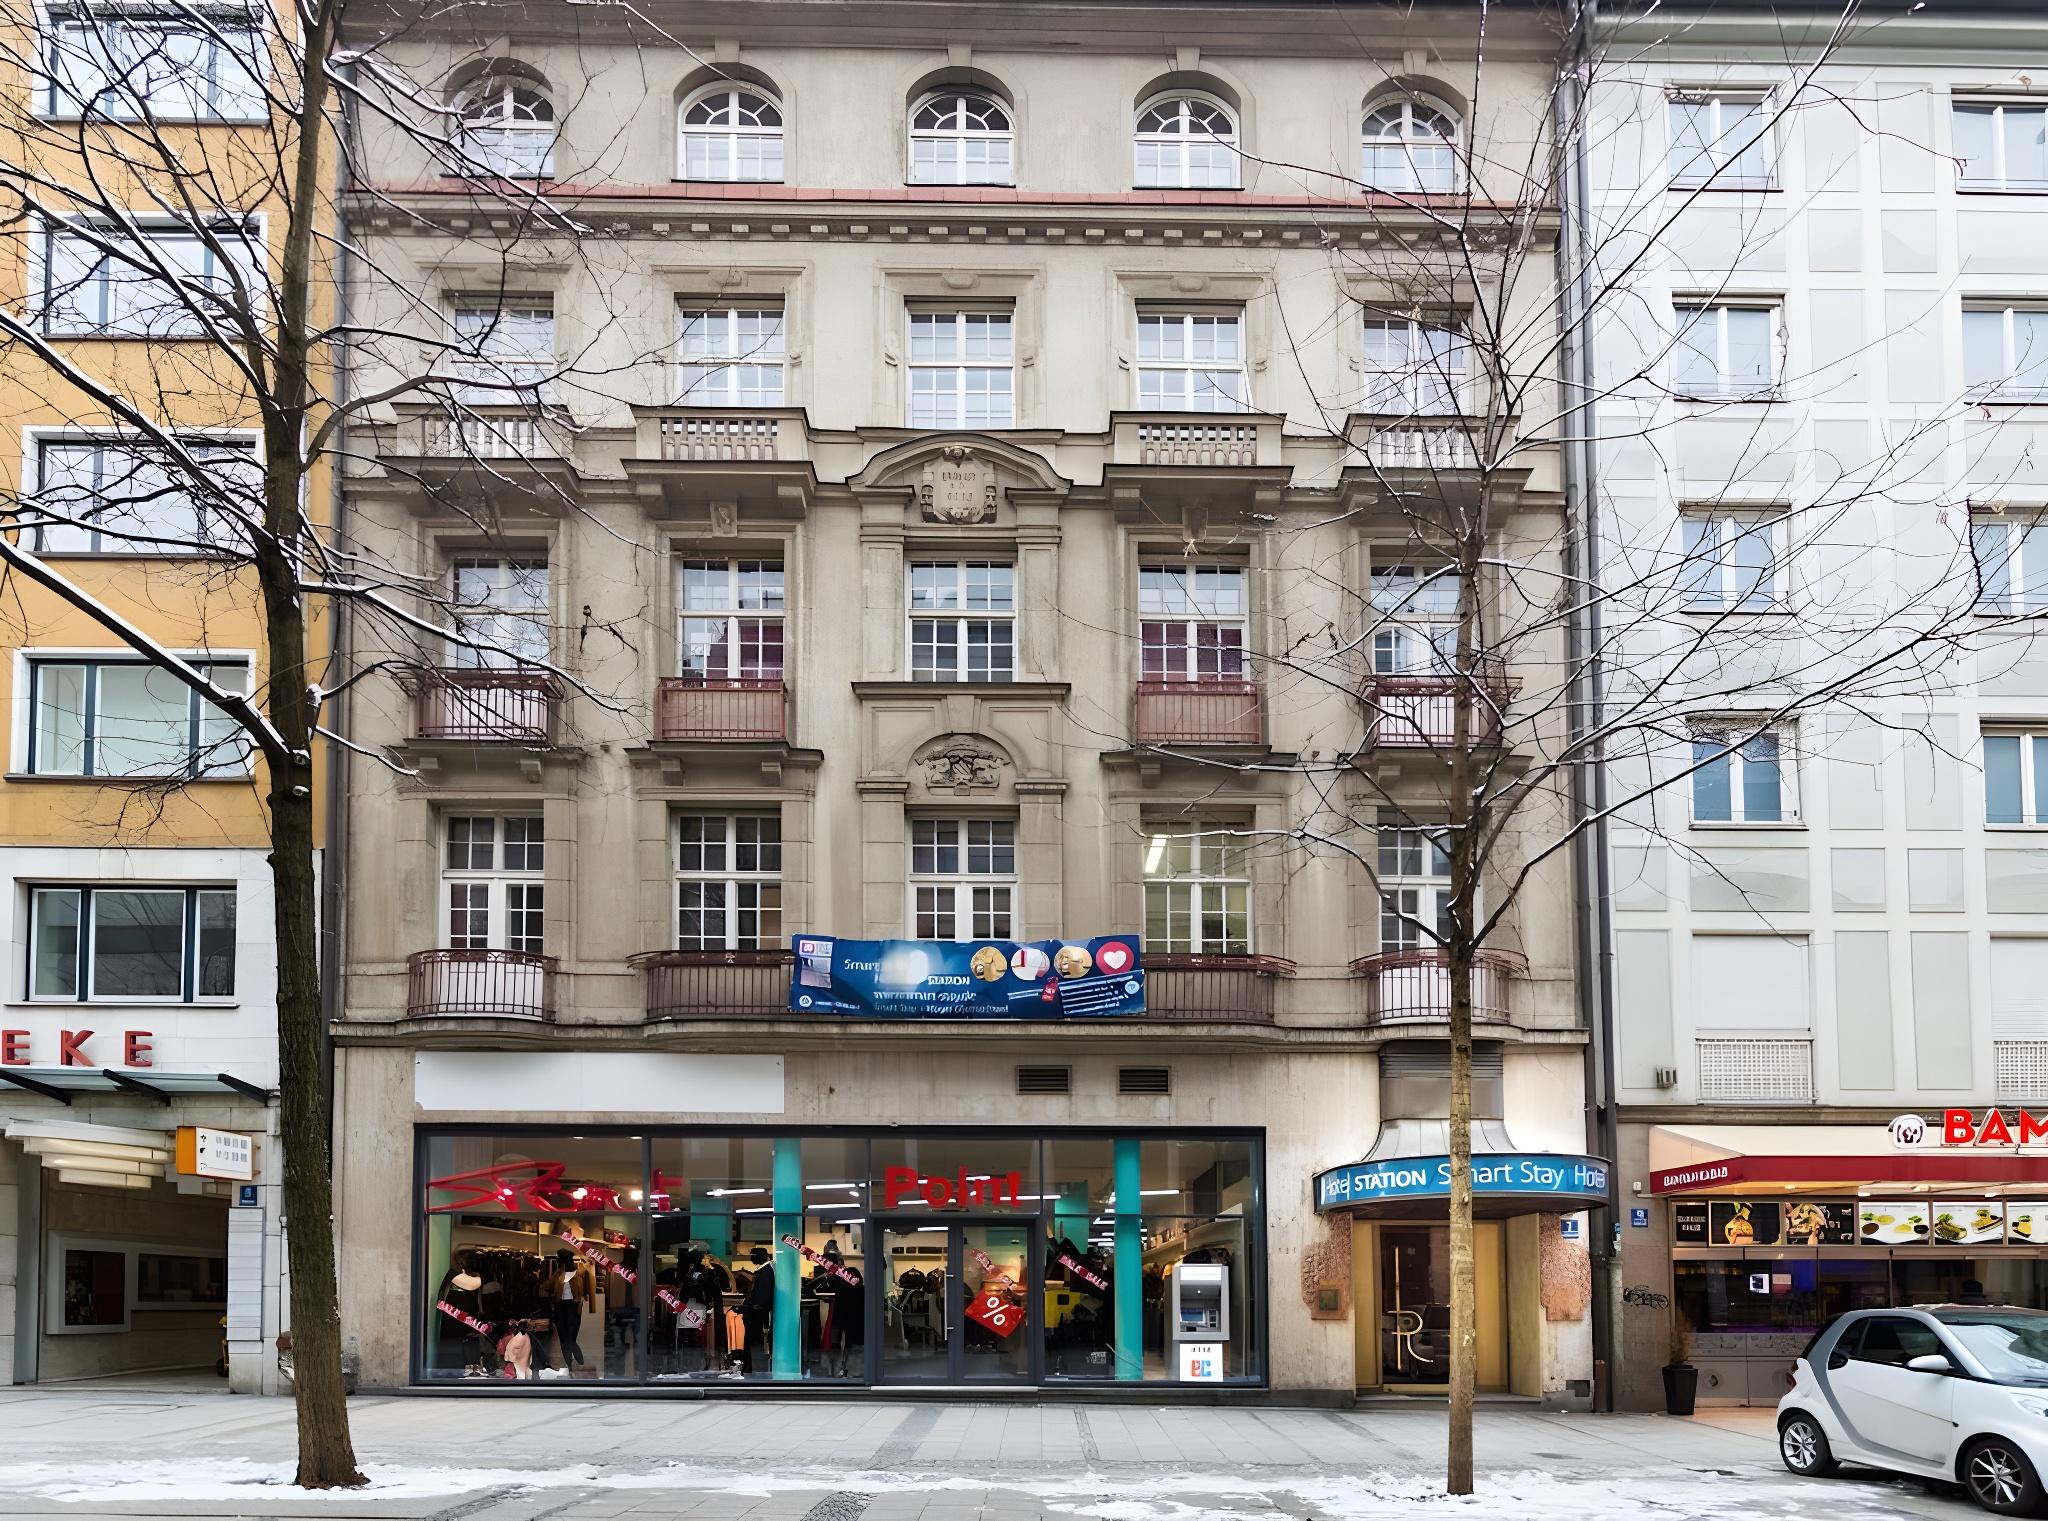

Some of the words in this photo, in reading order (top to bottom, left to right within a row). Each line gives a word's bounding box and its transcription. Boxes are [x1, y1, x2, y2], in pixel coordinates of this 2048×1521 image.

[1, 1030, 153, 1067] EKE
[1354, 1168, 1427, 1192] STATION
[1520, 1161, 1564, 1190] Stay
[982, 1296, 1010, 1326] %
